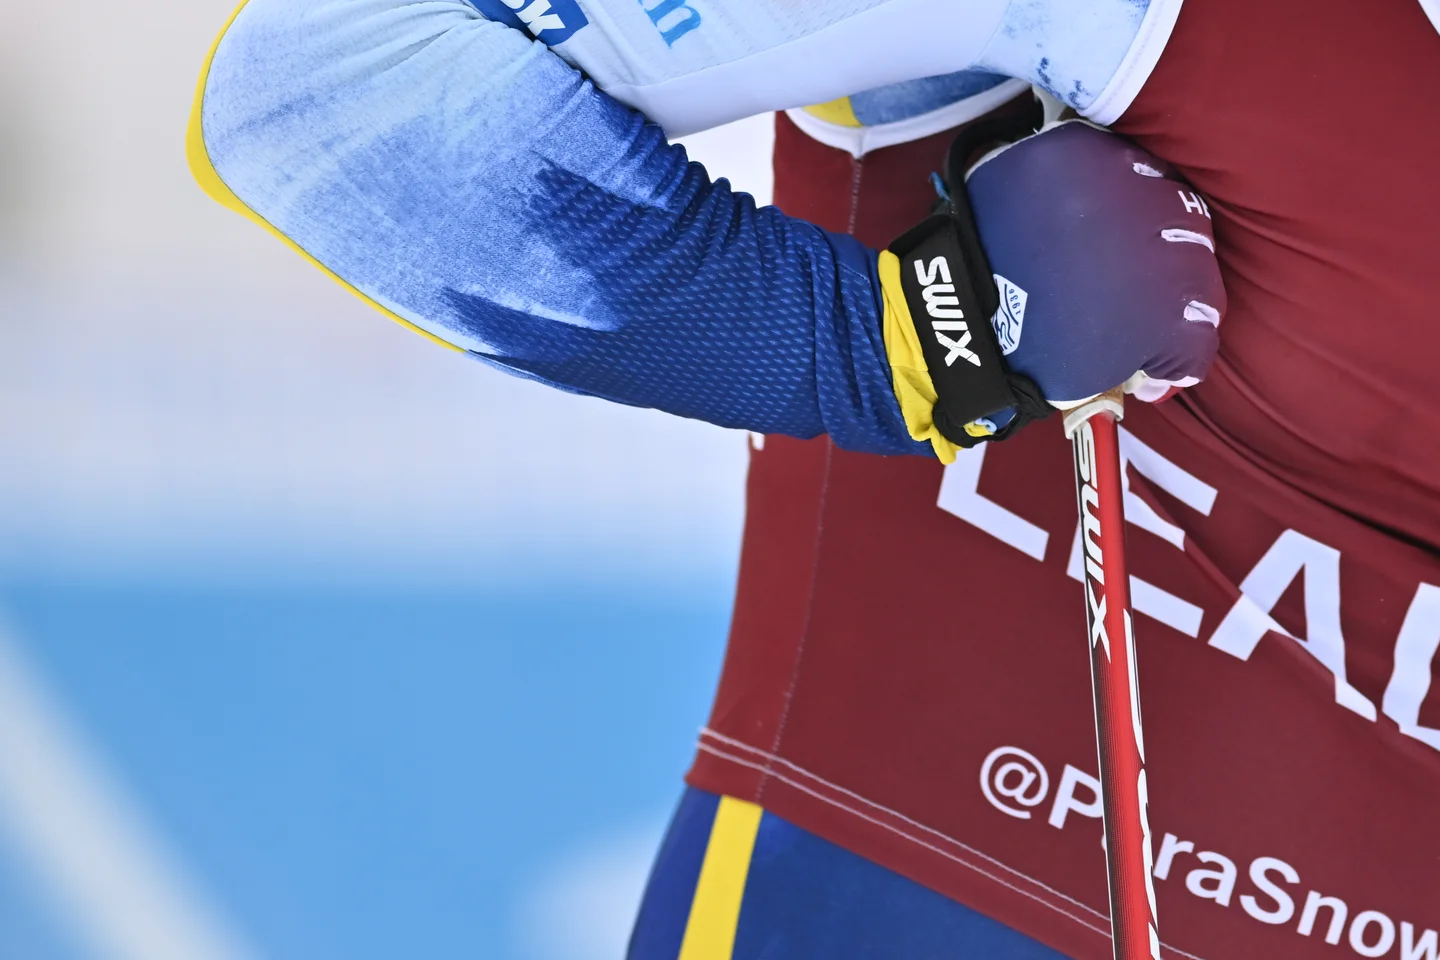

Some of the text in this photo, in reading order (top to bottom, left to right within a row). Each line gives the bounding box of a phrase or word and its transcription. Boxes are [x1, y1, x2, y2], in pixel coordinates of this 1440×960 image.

[913, 255, 982, 368] SWIX
[1008, 288, 1021, 316] 1936
[1076, 419, 1112, 665] SWIX
